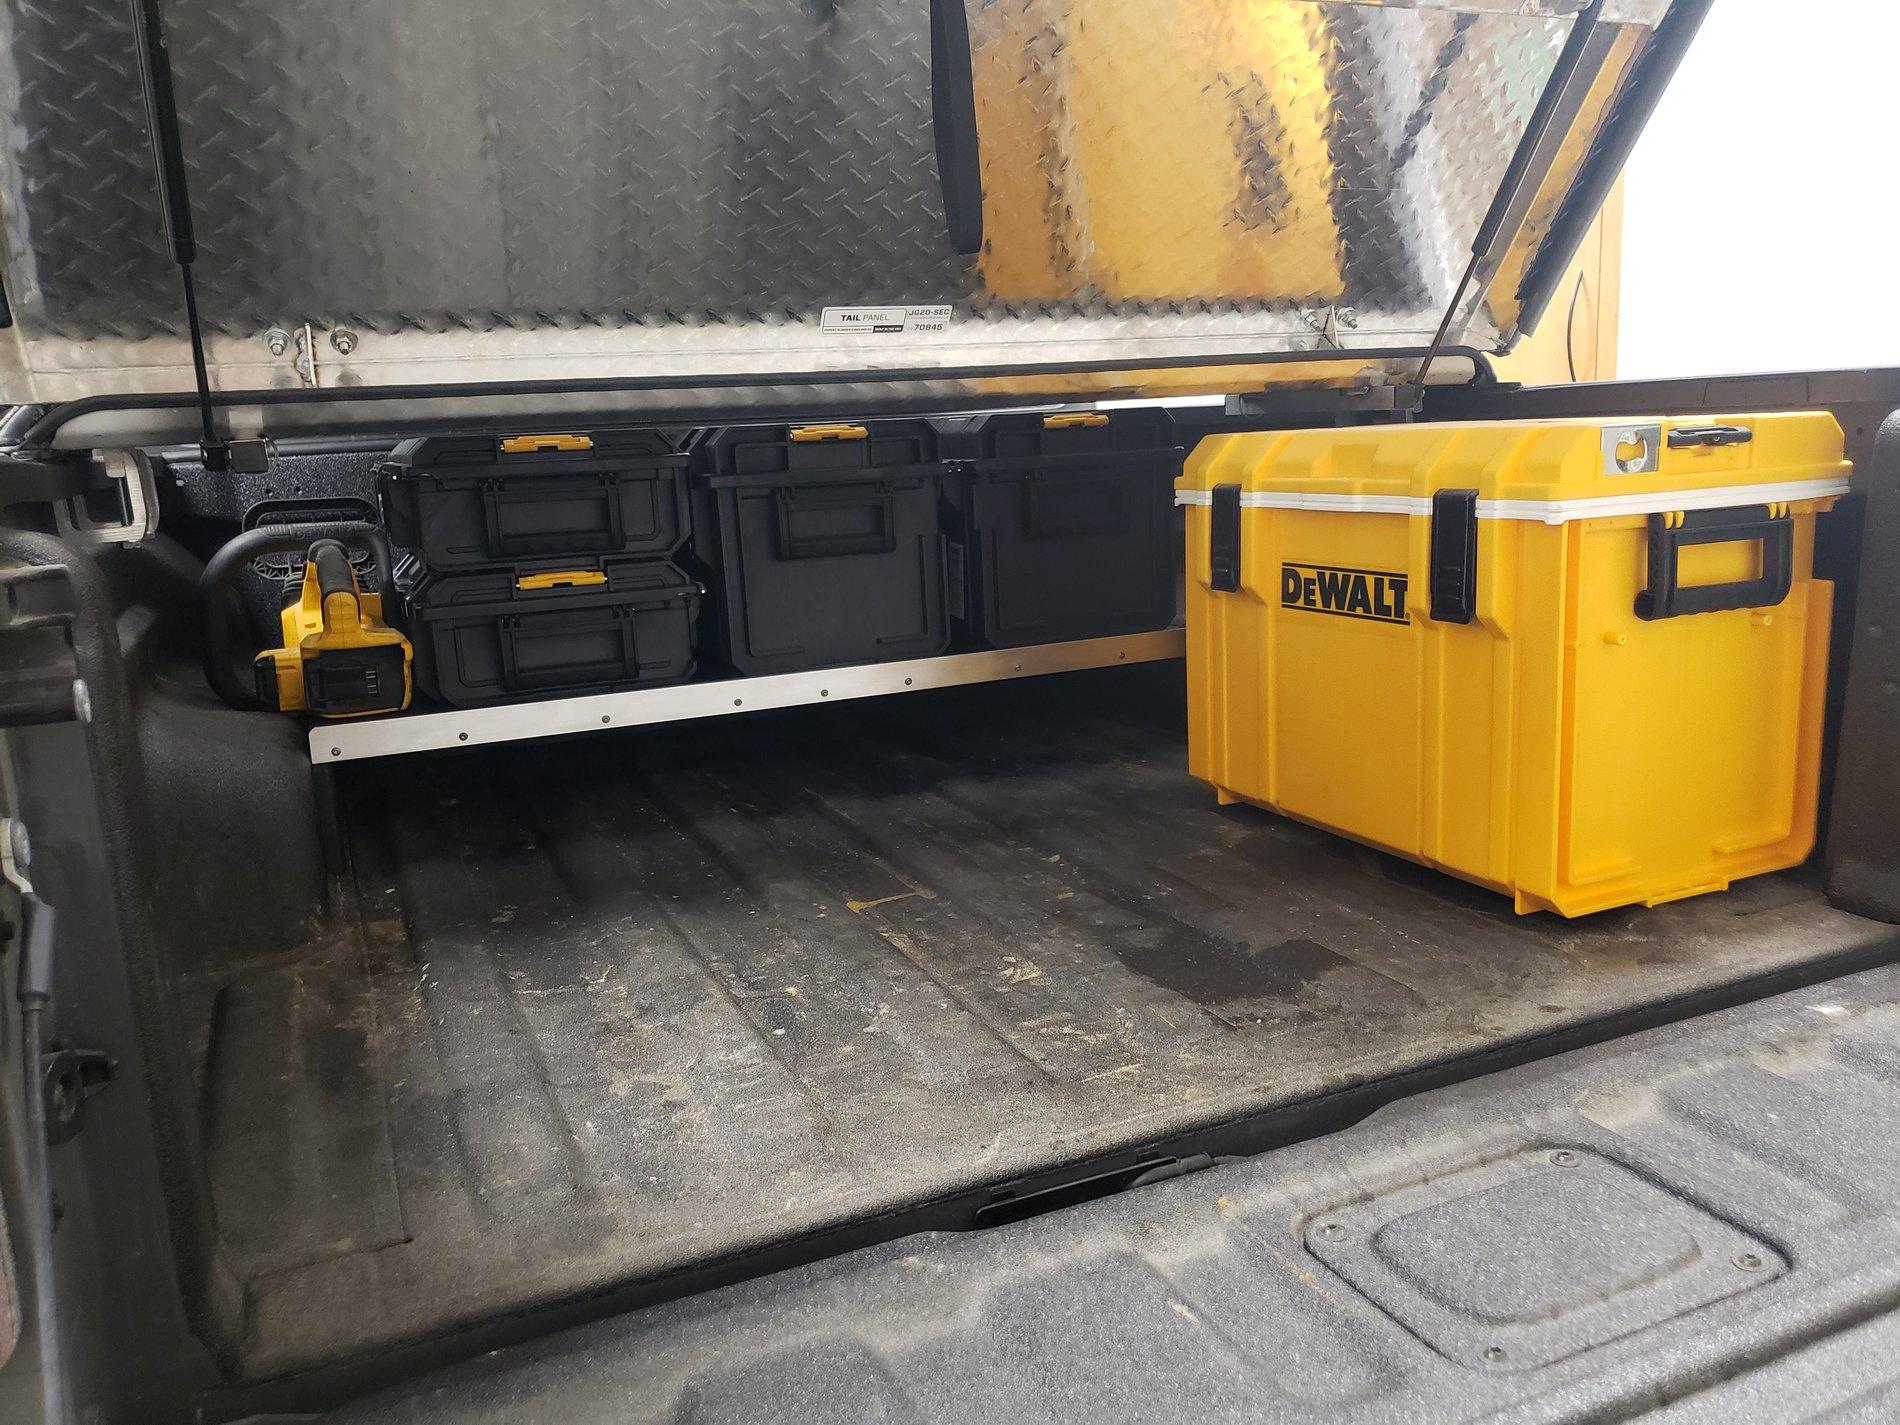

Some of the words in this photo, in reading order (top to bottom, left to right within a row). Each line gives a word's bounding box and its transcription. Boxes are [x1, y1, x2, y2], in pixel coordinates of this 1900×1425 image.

[909, 308, 950, 316] JG20-SEC
[841, 314, 861, 322] TAIL
[862, 313, 890, 322] PANEL
[914, 323, 943, 331] 70845
